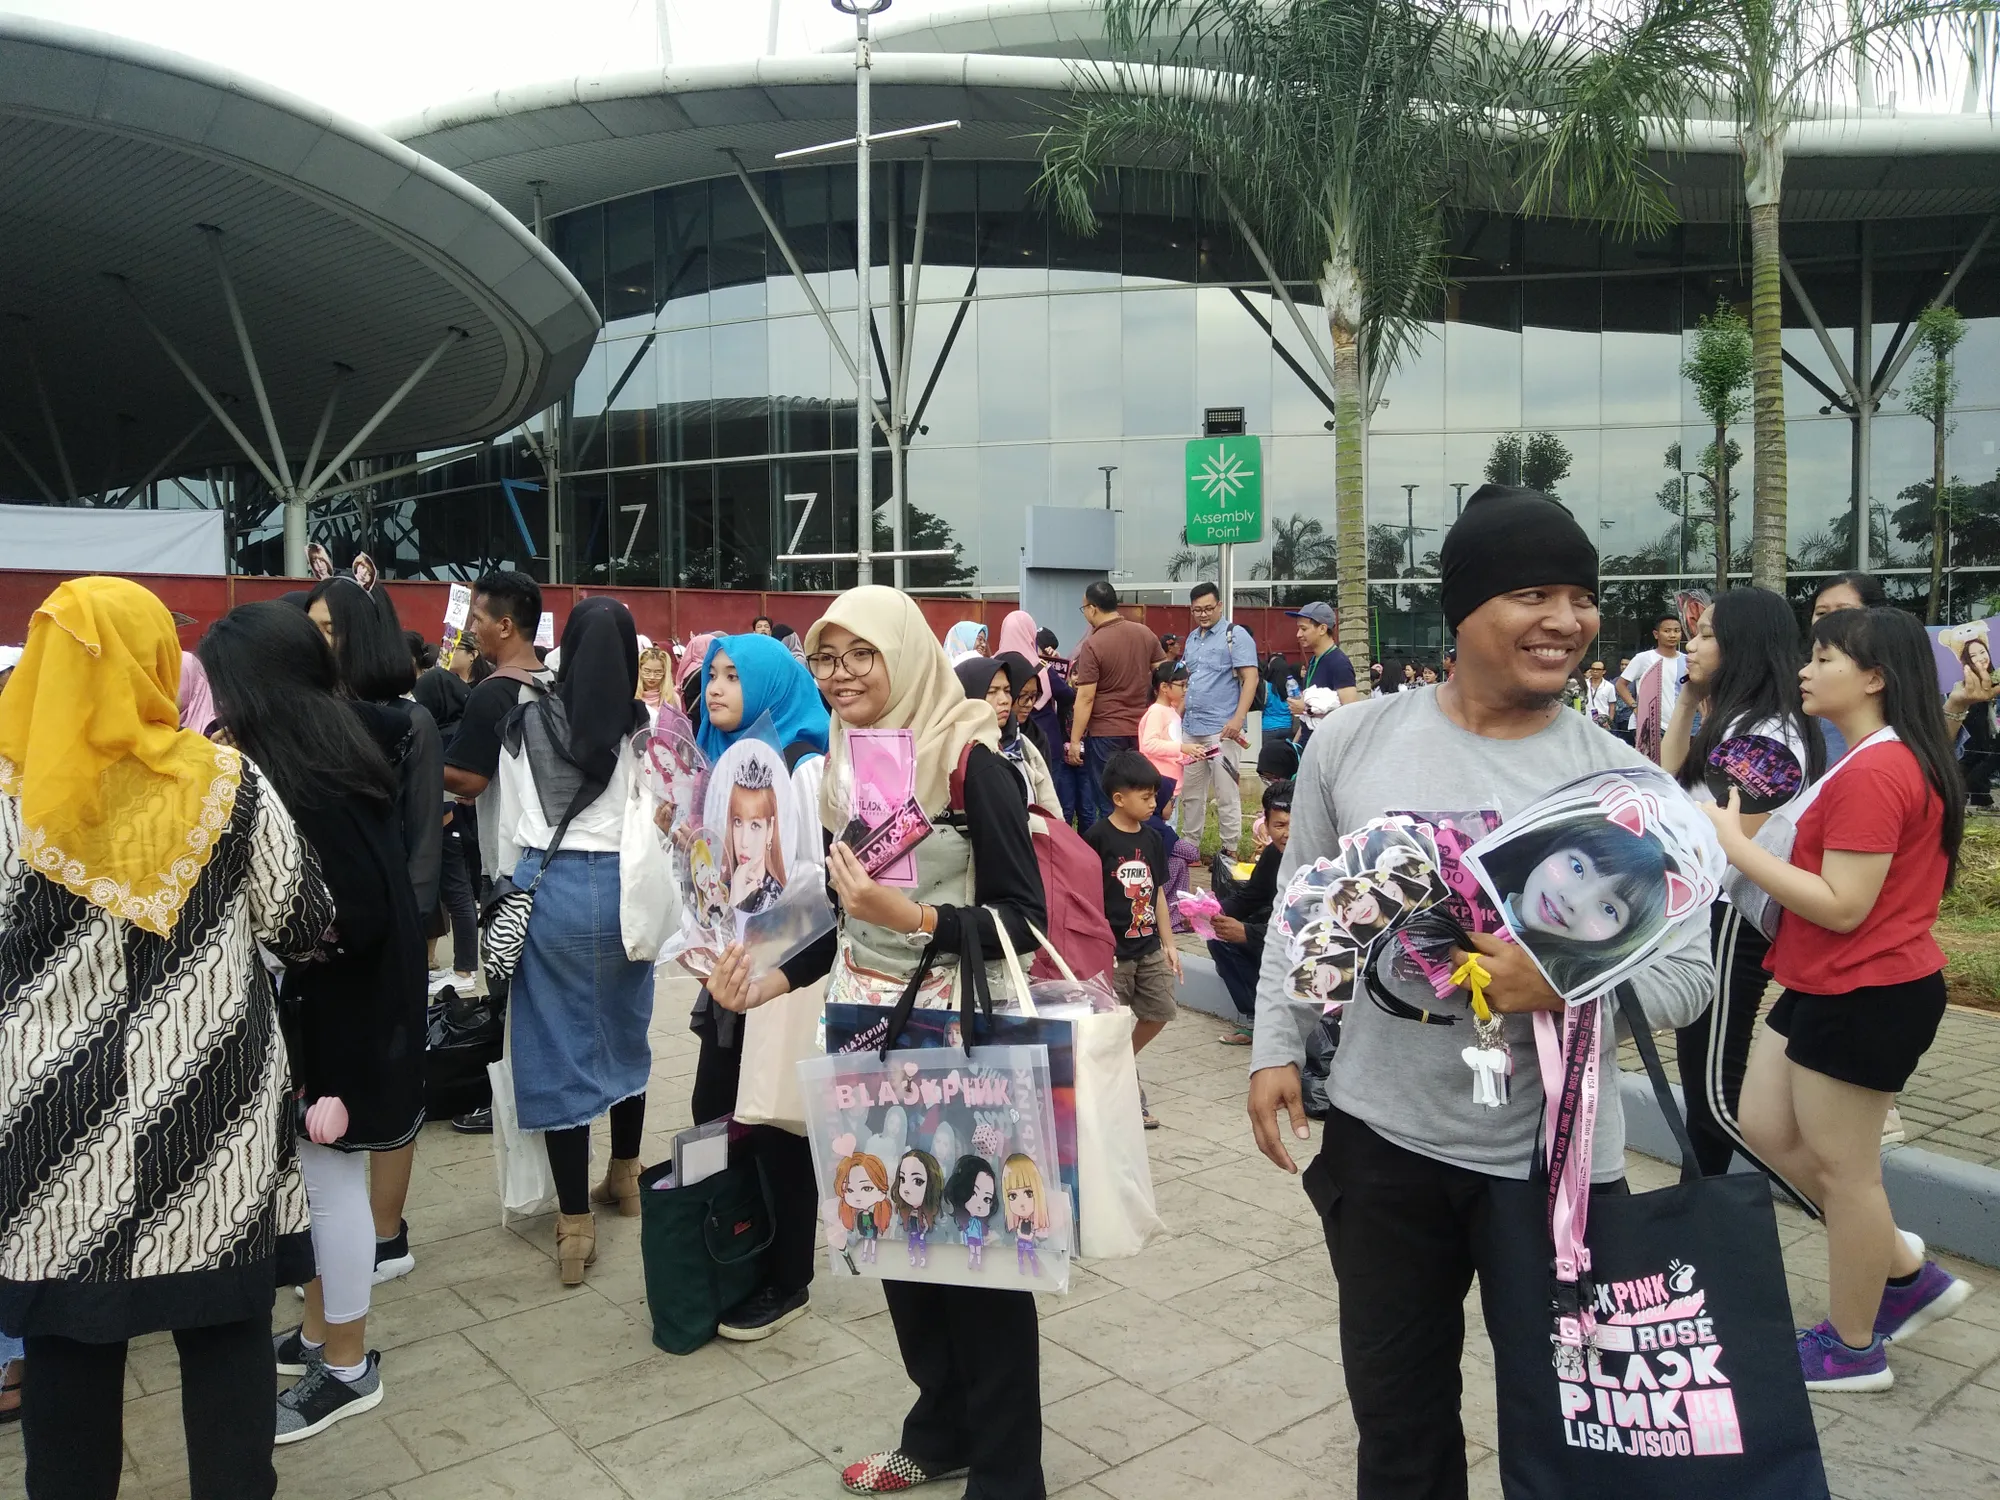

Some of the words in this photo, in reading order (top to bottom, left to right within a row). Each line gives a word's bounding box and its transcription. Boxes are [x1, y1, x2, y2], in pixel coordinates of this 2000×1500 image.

[1192, 509, 1256, 524] Assembly
[1206, 525, 1241, 539] Point
[1724, 755, 1776, 797] BLACKPINK
[1120, 867, 1146, 879] STRIKE
[1568, 1073, 1580, 1090] ROSE
[1587, 1074, 1595, 1089] LISA
[835, 1077, 1011, 1109] BLACKPINK
[1564, 1092, 1576, 1110] JISOO
[1586, 1093, 1595, 1114] JENNIE
[1560, 1113, 1572, 1135] JENNIE
[1557, 1137, 1567, 1152] LISA
[1636, 1303, 1668, 1324] your
[1636, 1309, 1718, 1351] ROSÉ
[1556, 1345, 1731, 1391] BLACK
[1559, 1382, 1690, 1430] PINK
[1564, 1419, 1625, 1454] LISA
[1625, 1430, 1692, 1457] JISOO
